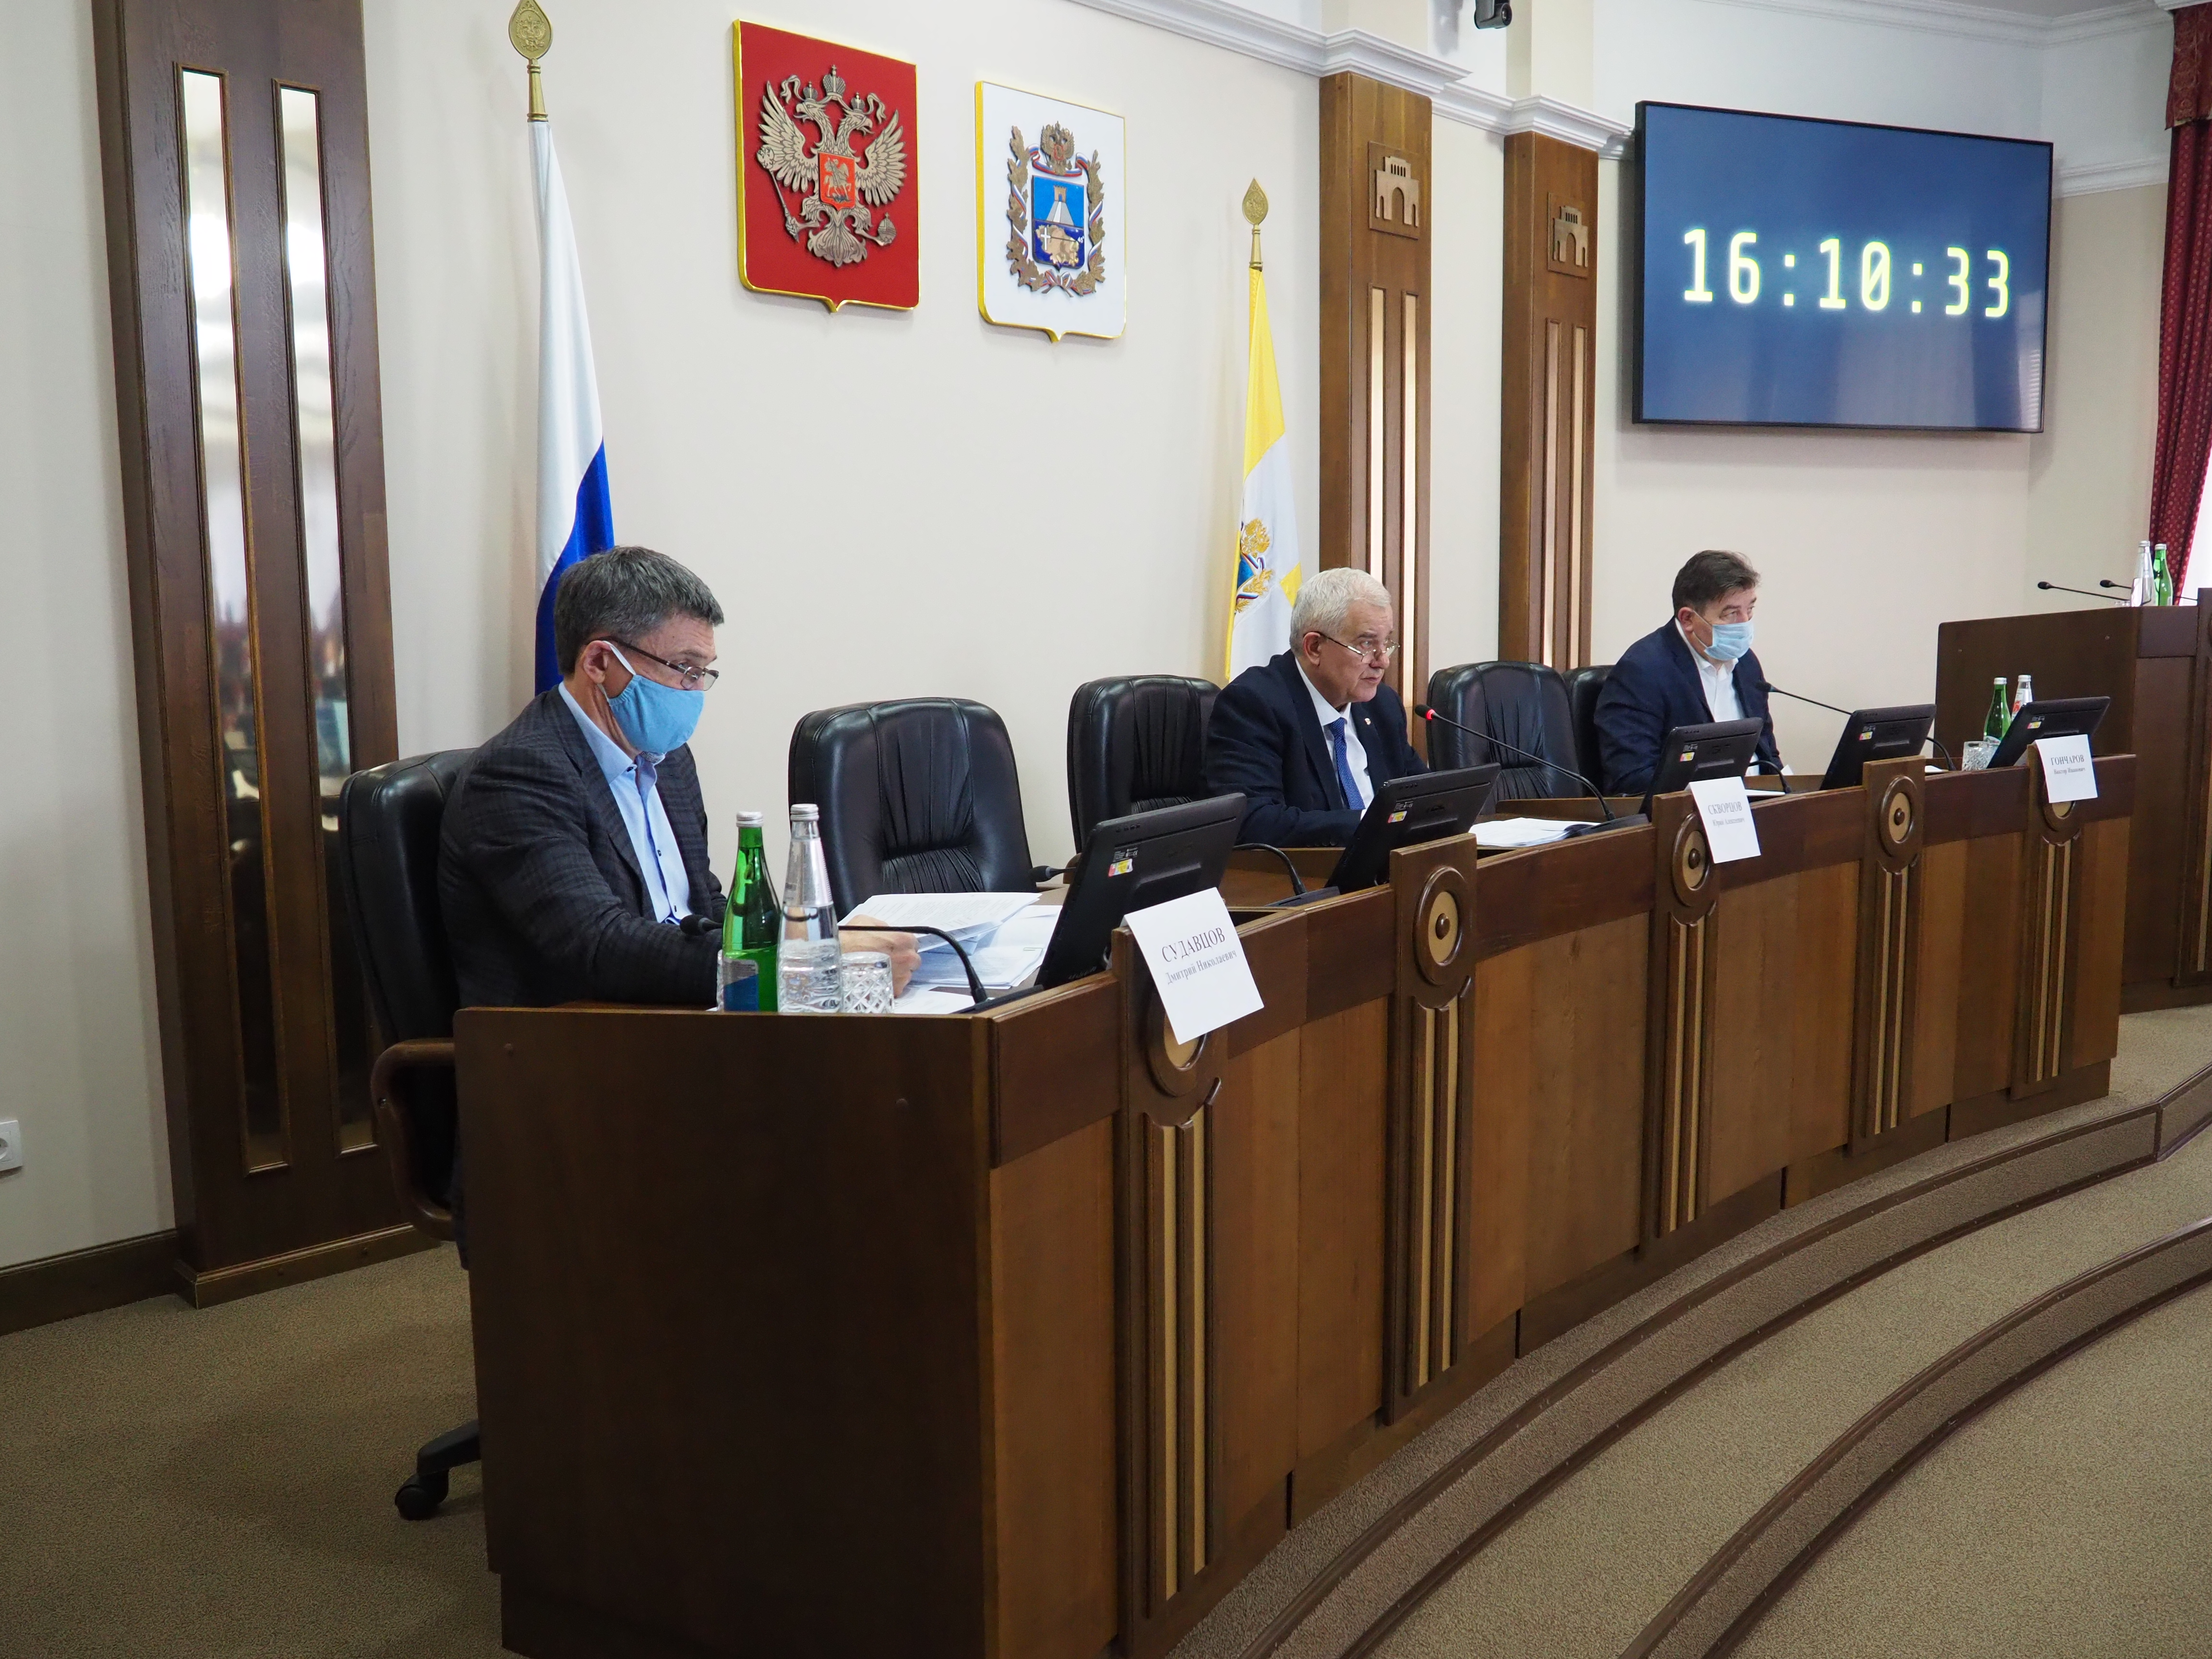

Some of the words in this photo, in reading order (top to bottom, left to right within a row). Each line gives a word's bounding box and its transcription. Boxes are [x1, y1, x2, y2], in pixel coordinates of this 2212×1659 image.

[1683, 228, 2009, 318] 16:10:33
[2051, 755, 2084, 766] ГОНЧАРОВ
[1708, 801, 1743, 815] СКВОРЦОВ
[1162, 927, 1225, 962] СУДАВЦОВ
[1165, 963, 1197, 985] Дмитрий
[1196, 950, 1237, 972] Николаевич
